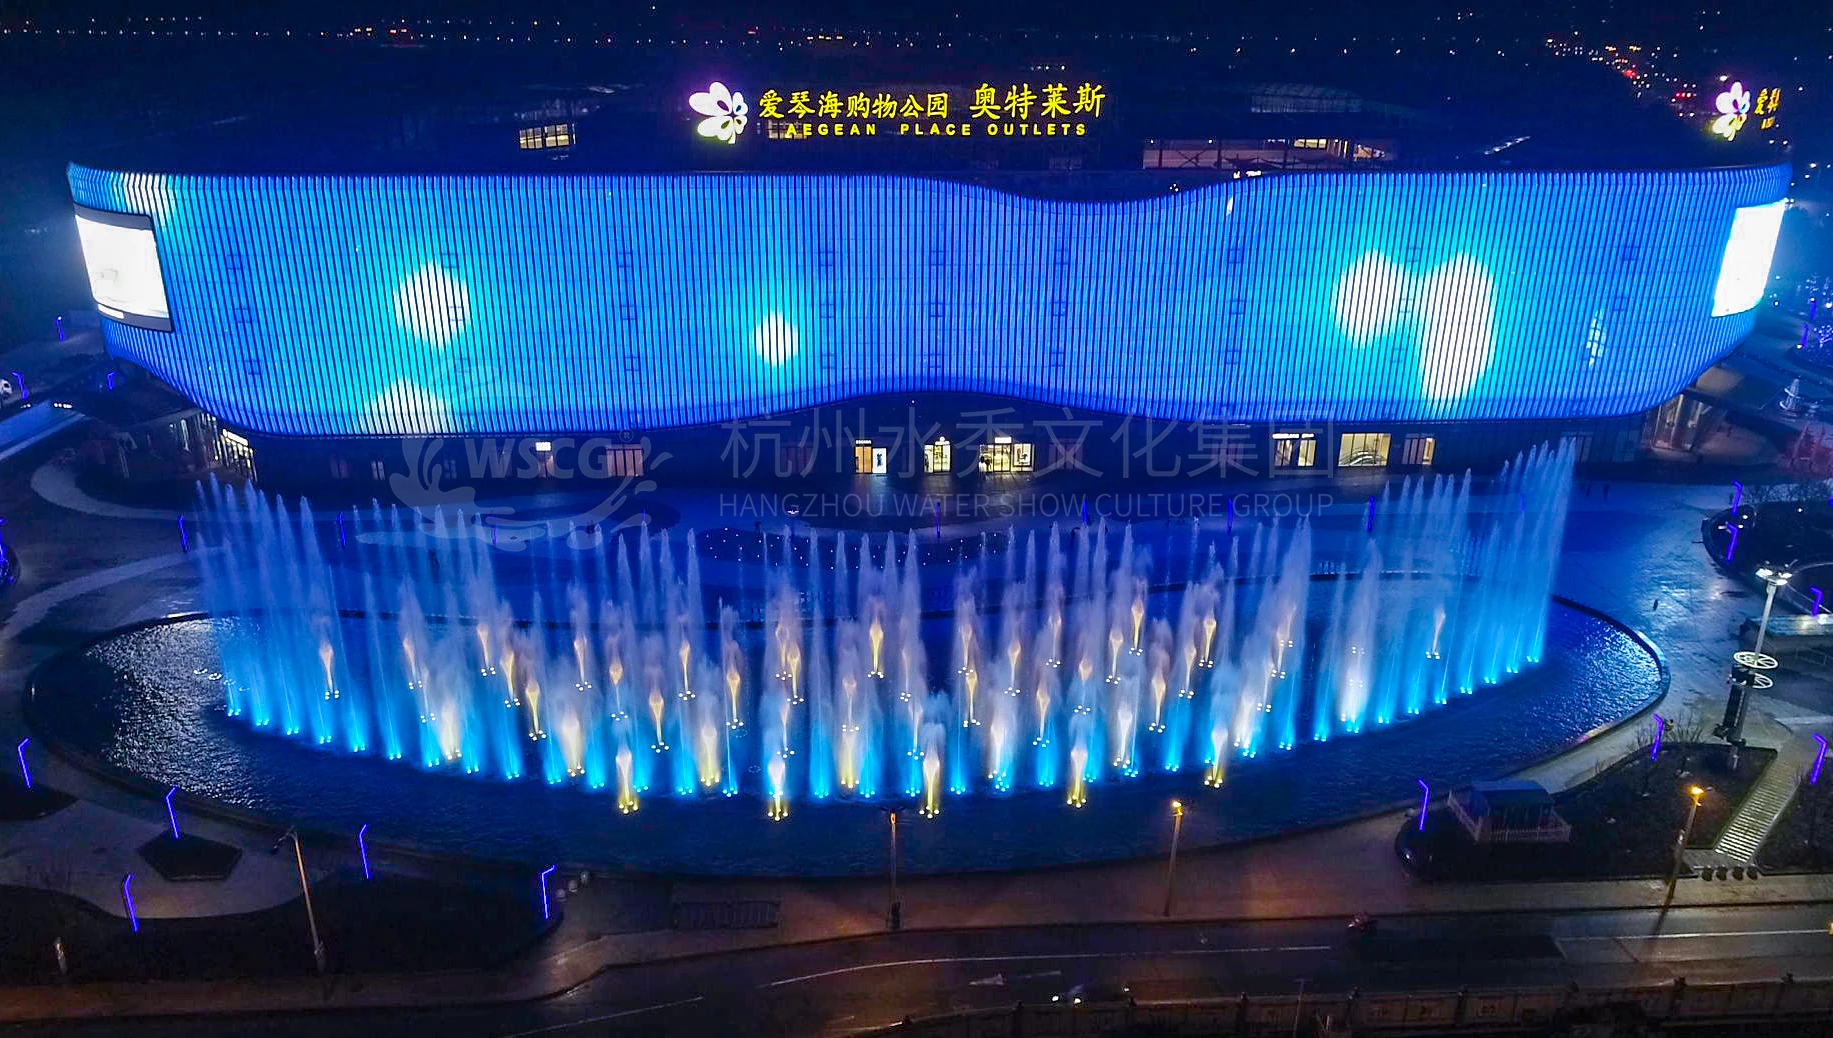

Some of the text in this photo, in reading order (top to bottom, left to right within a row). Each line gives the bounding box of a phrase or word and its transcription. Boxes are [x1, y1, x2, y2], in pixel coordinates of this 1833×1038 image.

[759, 82, 1106, 120] 爱琴海购物公园 奥特莱斯
[785, 122, 1087, 137] AEGEAN PLACE OUTLETS
